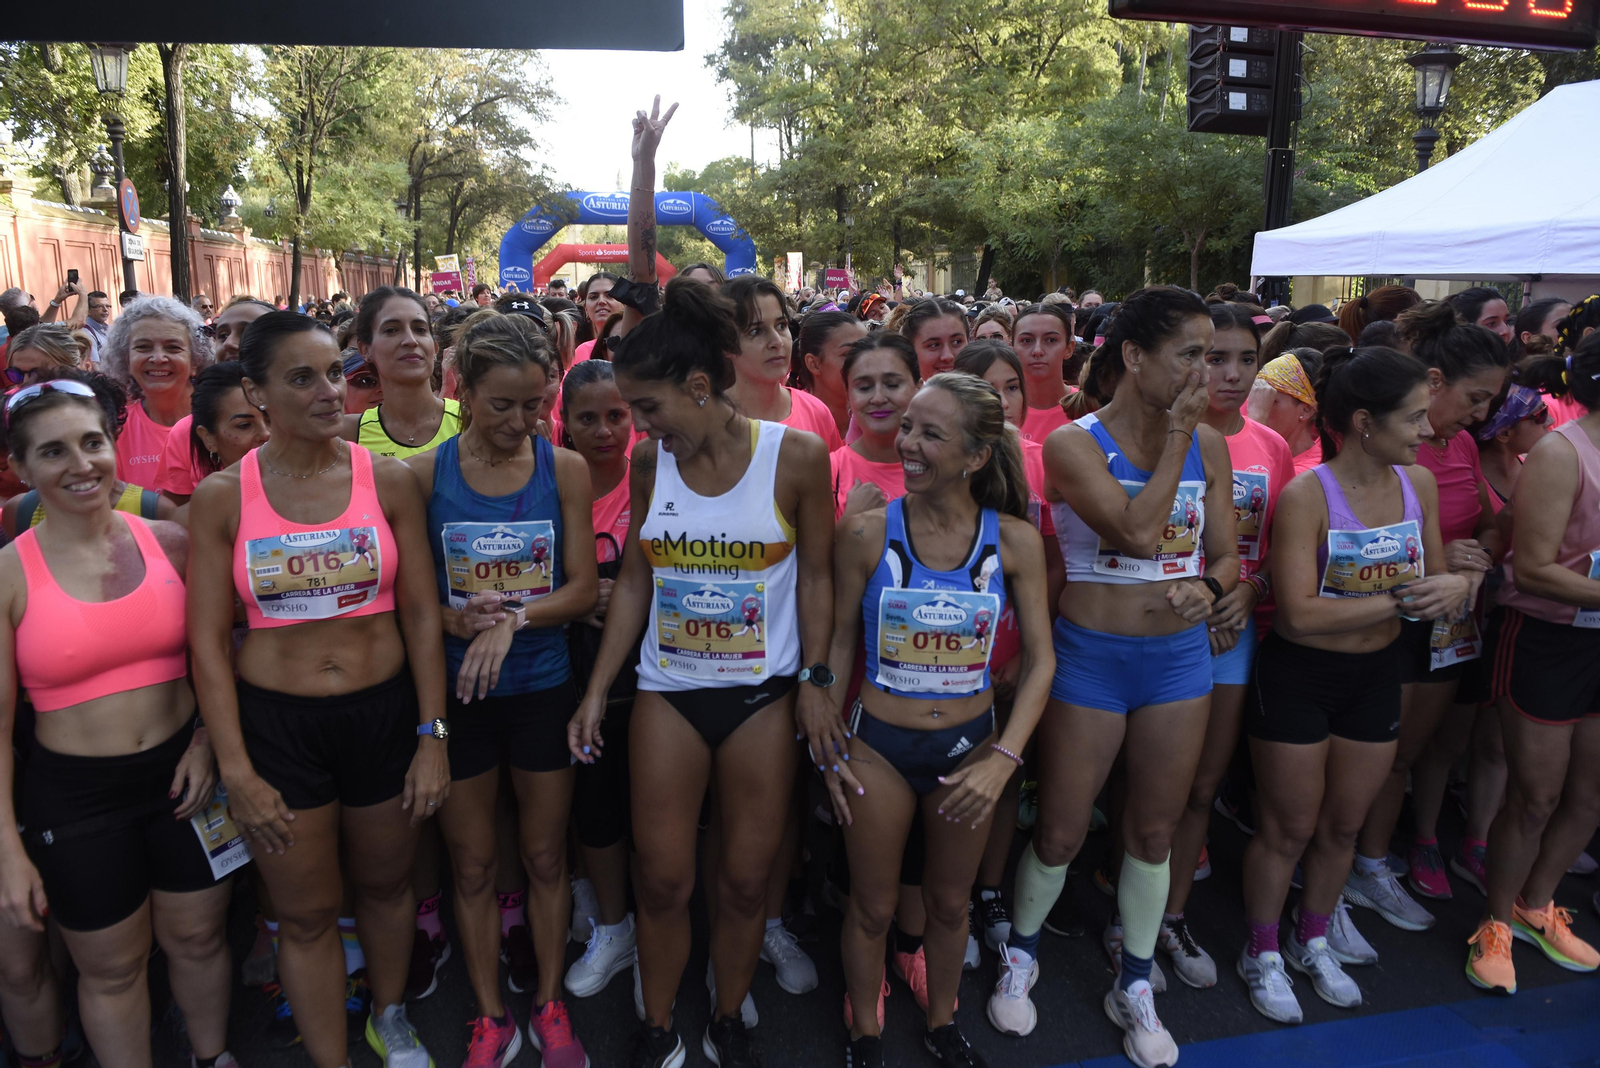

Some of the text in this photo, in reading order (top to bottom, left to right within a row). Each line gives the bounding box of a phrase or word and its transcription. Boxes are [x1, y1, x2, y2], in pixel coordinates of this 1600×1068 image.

[661, 203, 689, 212] ASTURIANA
[503, 271, 529, 279] ASTURIANA
[284, 529, 337, 544] ASTURIANA
[475, 541, 521, 551] ASTURIANA
[651, 530, 765, 559] eMotion
[1363, 545, 1400, 556] ASTURIANA
[287, 551, 342, 576] 016
[475, 561, 521, 579] 016
[674, 560, 739, 581] running
[1359, 562, 1399, 581] 016
[306, 577, 327, 587] 781
[493, 582, 505, 591] 13
[281, 590, 312, 599] CARRERA
[333, 584, 355, 594] MUJER
[1343, 590, 1370, 598] CARRERA
[271, 603, 308, 613] OYSHO
[685, 597, 731, 610] ASTURIANA
[915, 610, 964, 621] ASTURIANA
[685, 619, 732, 639] 016
[705, 642, 711, 651] 2
[912, 631, 961, 652] 016
[676, 648, 701, 659] CARRERA
[721, 652, 743, 661] MUJER
[933, 655, 938, 664] 1
[726, 665, 752, 673] Santand
[898, 662, 927, 672] CARRERA
[885, 672, 921, 686] OYSHO
[947, 743, 974, 758] adidas
